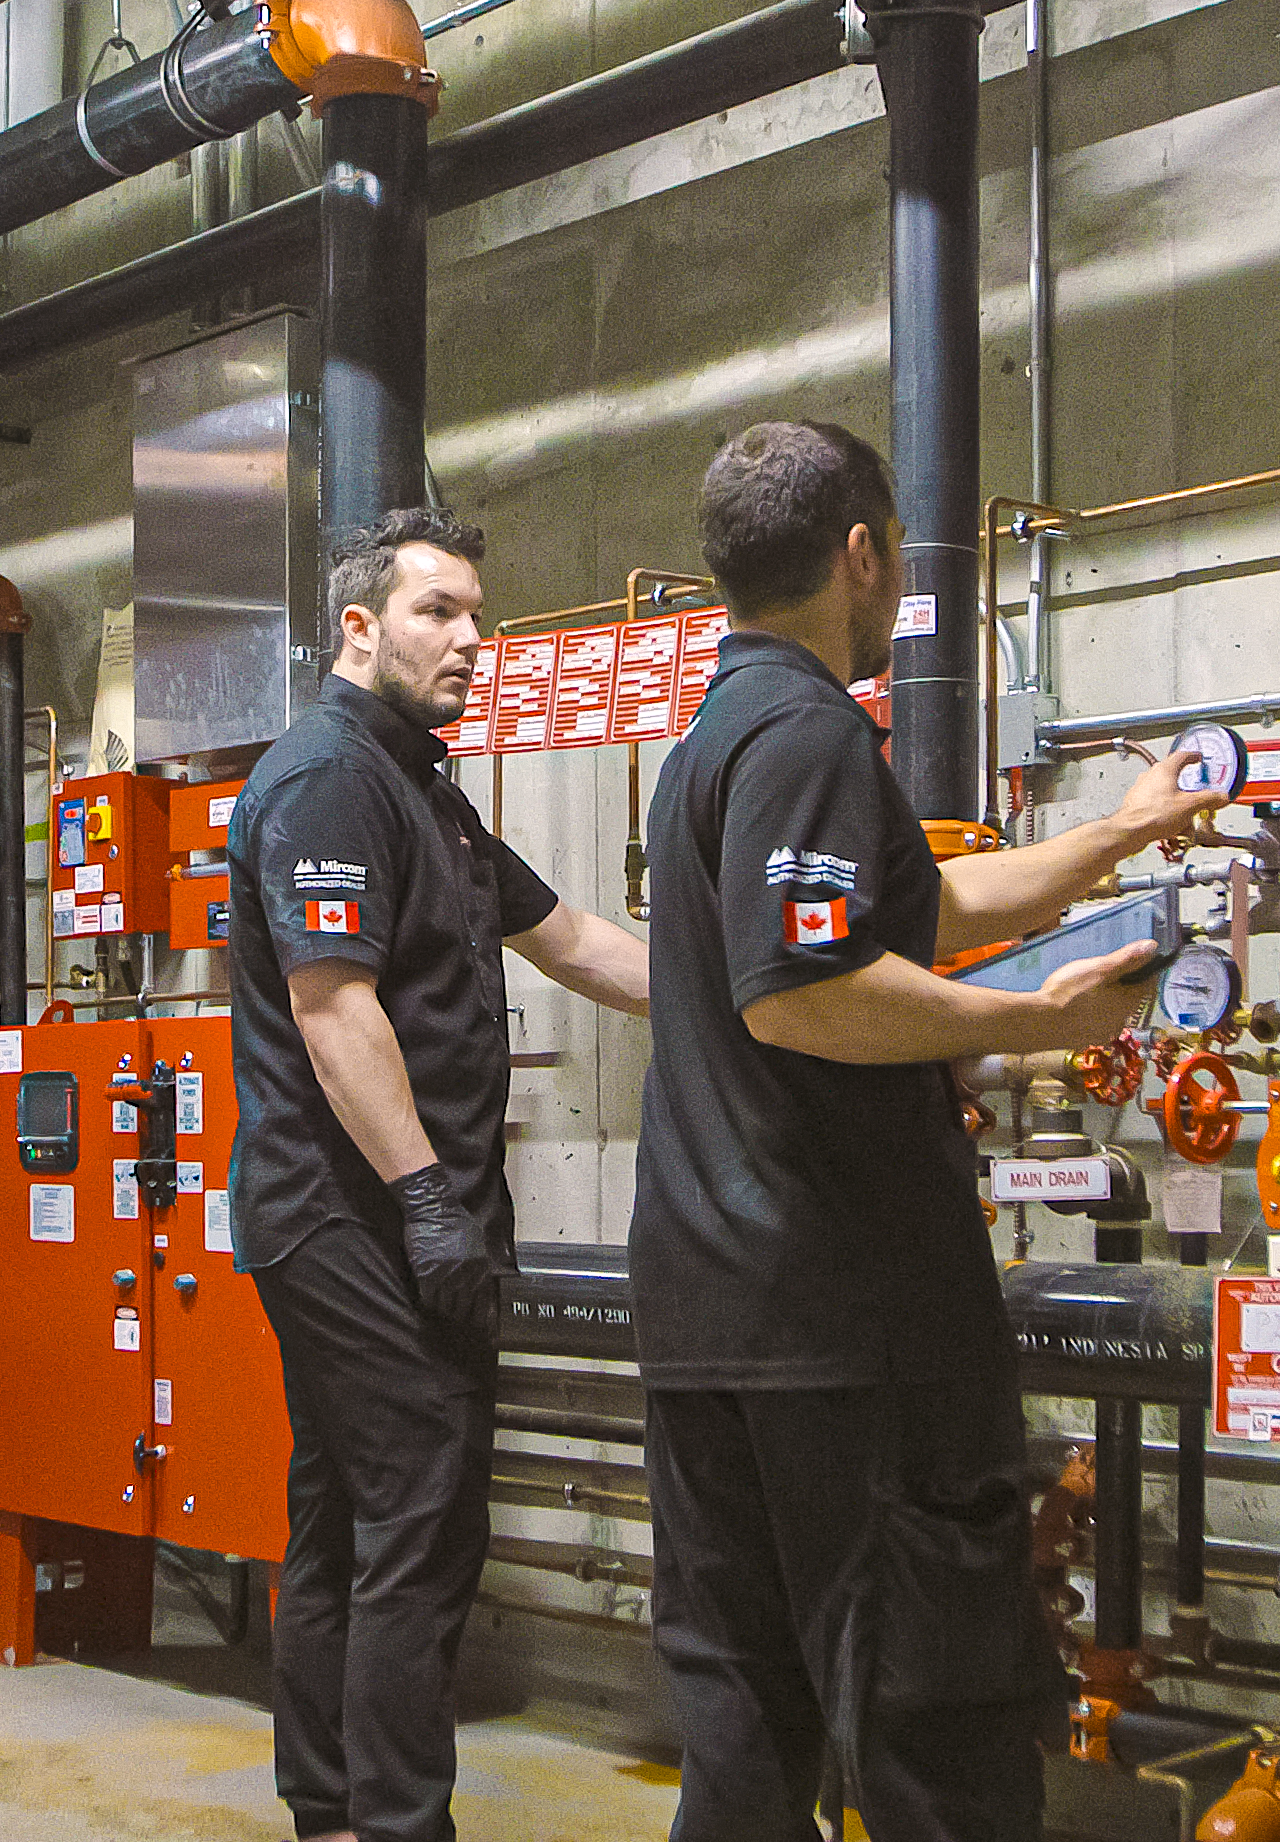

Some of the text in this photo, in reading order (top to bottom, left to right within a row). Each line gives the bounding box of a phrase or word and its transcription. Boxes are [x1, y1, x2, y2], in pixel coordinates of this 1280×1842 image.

[320, 859, 366, 876] Mircom
[1010, 1170, 1089, 1188] MAIN DRAIN
